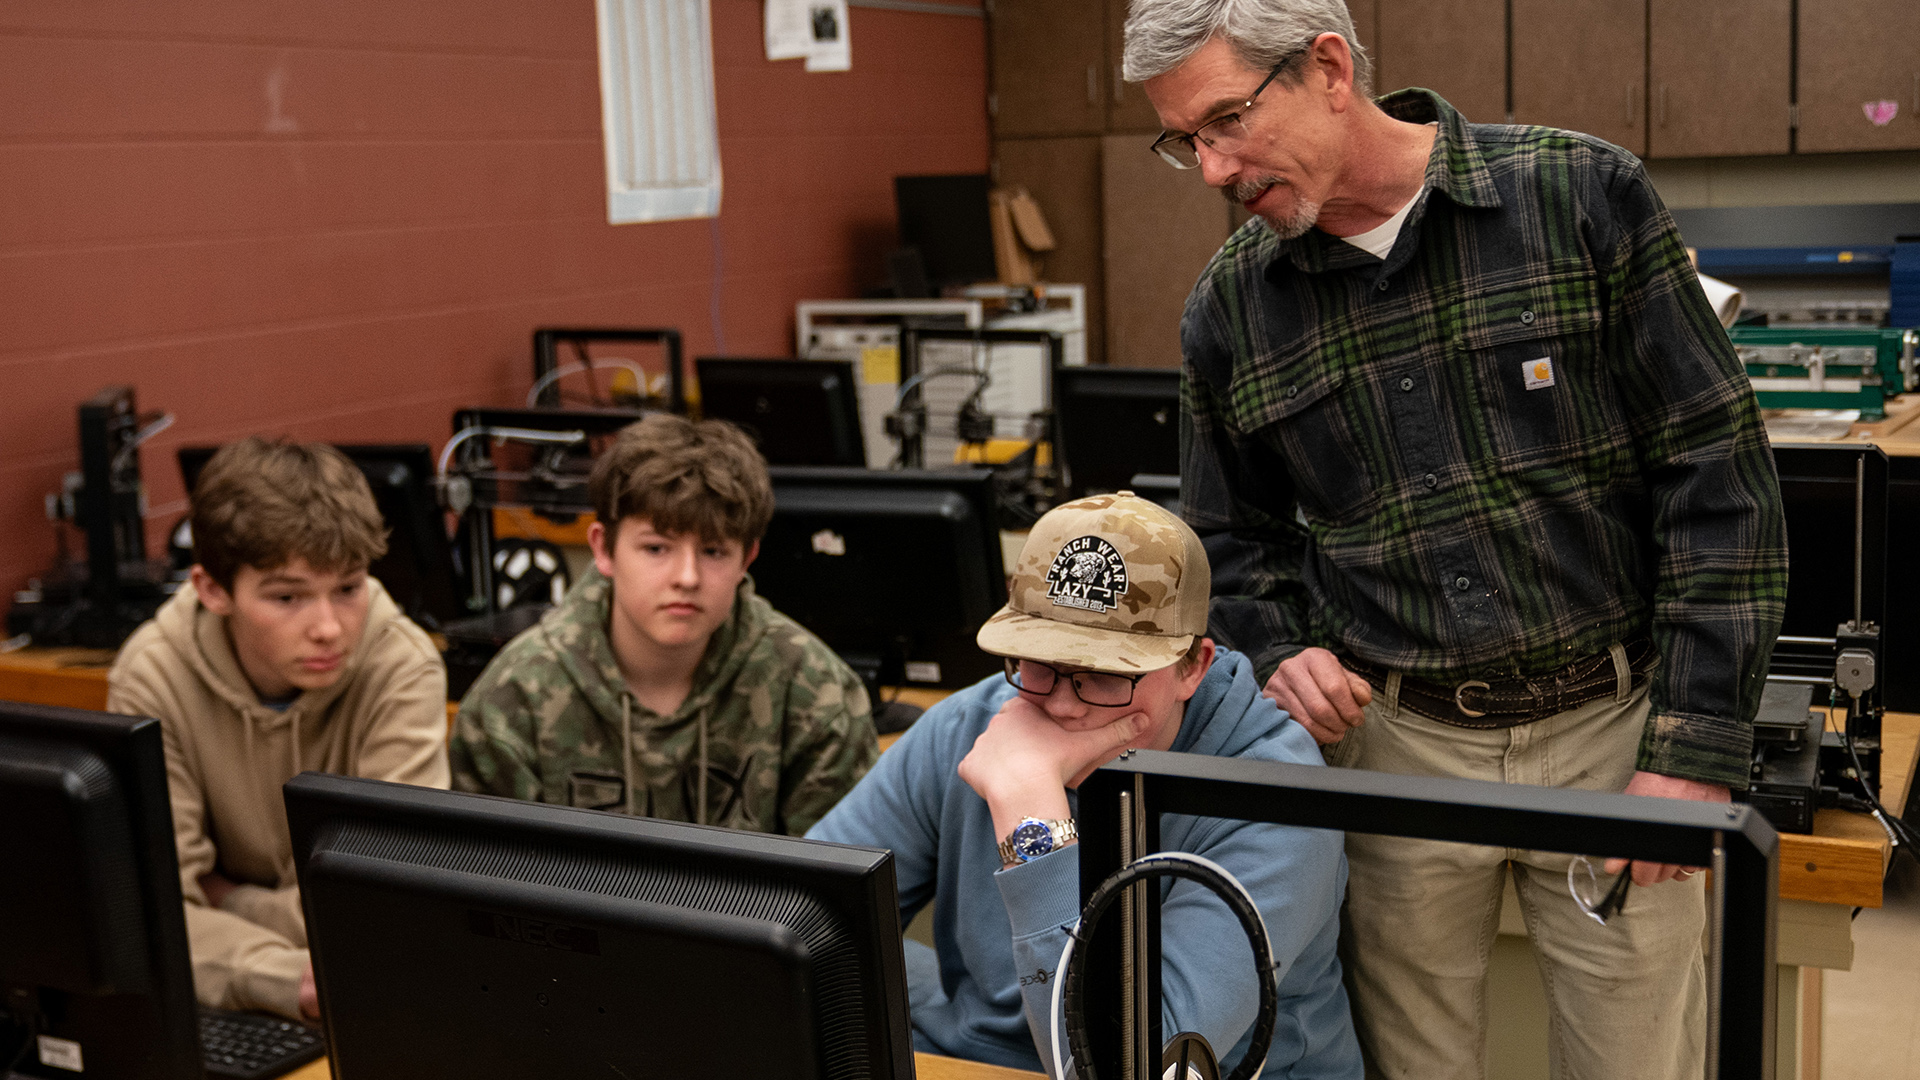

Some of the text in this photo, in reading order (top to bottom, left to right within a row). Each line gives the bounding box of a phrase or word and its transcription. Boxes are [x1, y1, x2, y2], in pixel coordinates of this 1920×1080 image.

[1052, 538, 1125, 582] RANCH WEAR
[1053, 581, 1092, 598] LAZY
[1057, 595, 1089, 608] ESTABLISHED
[492, 914, 573, 950] NEC
